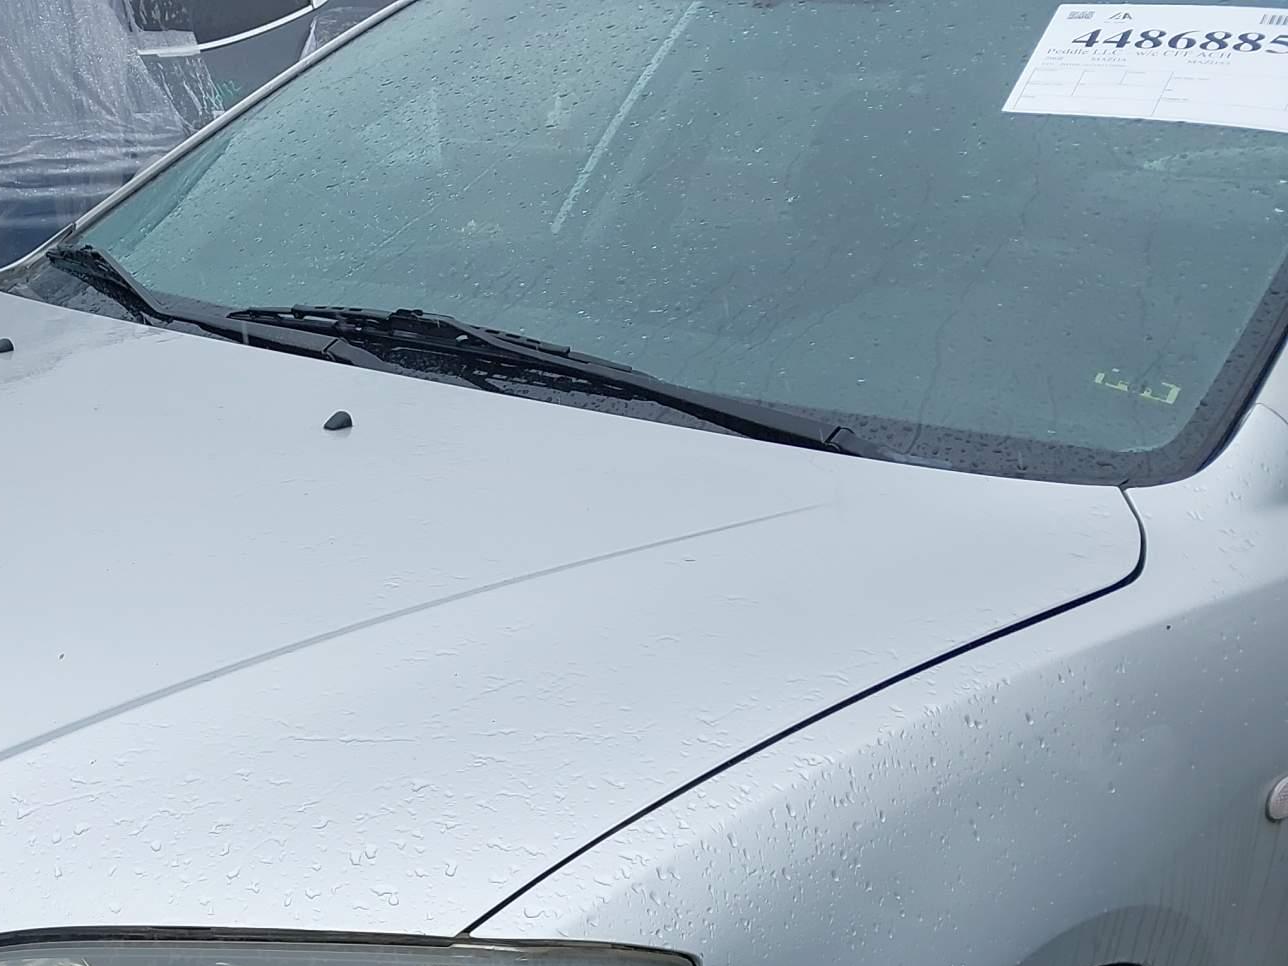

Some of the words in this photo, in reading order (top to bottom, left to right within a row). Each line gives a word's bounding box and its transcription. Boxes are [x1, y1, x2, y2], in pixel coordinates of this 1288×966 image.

[1071, 28, 1288, 54] 4486885
[1047, 47, 1089, 56] Peddle
[1092, 48, 1121, 56] LLC
